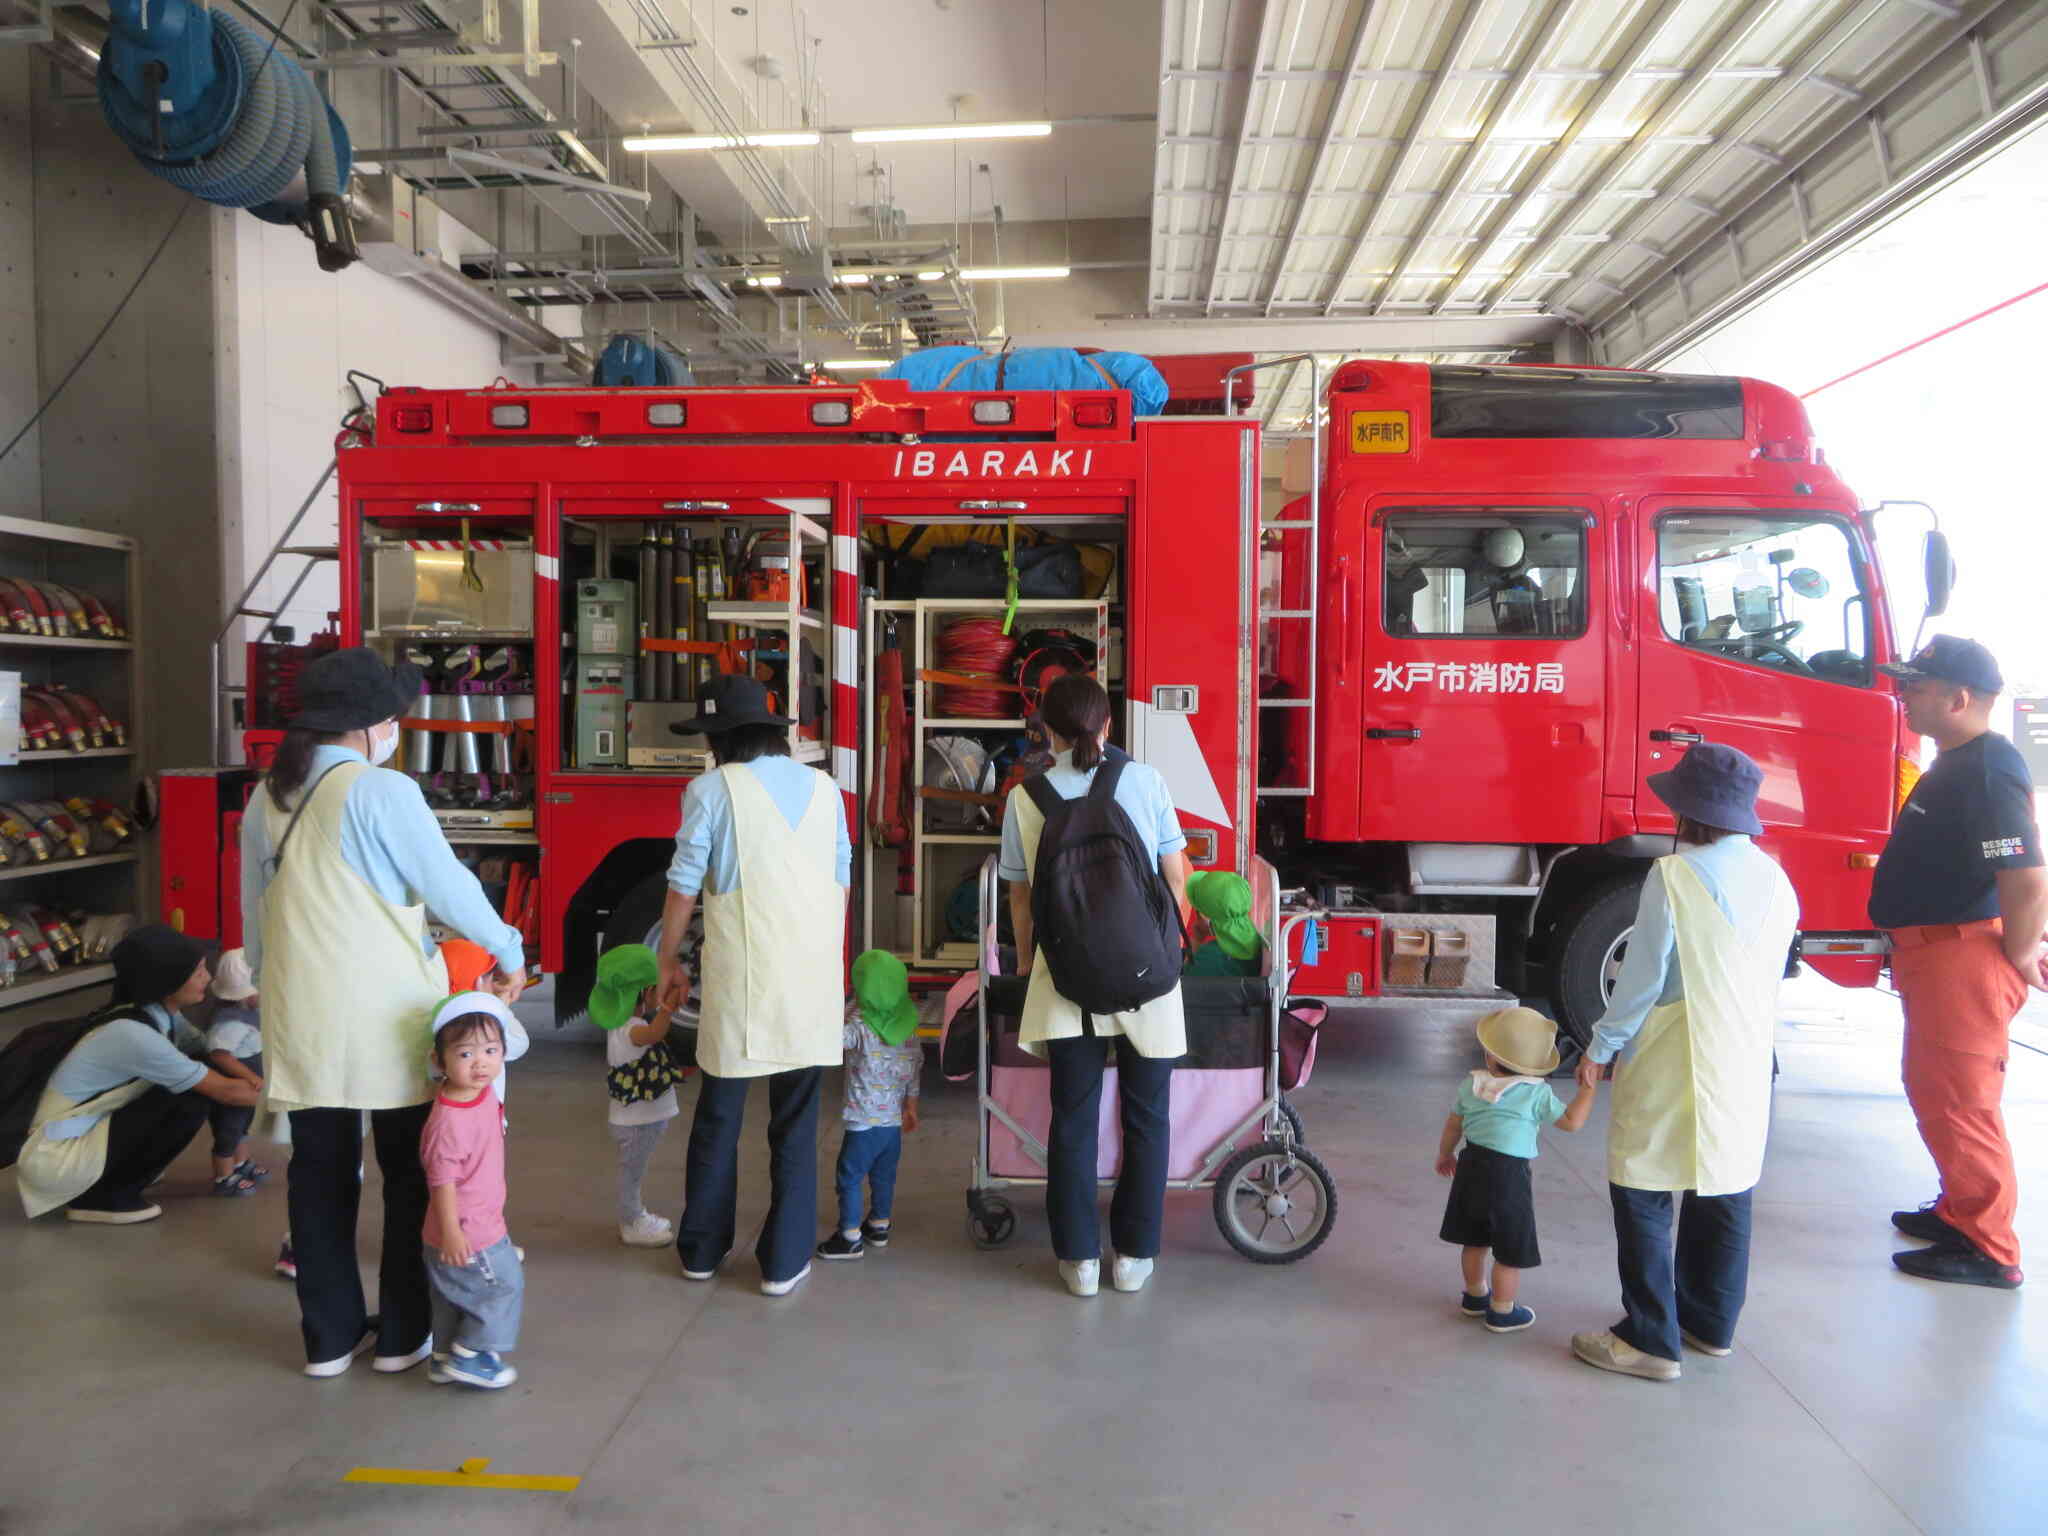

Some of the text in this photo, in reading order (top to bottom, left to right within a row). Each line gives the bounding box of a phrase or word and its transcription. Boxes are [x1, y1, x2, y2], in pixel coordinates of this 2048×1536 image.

[894, 450, 1093, 477] IBARAKI
[1373, 661, 1565, 693] 水戸市消防局
[1982, 837, 2023, 849] RESCUE
[1984, 847, 2016, 858] DIVER
